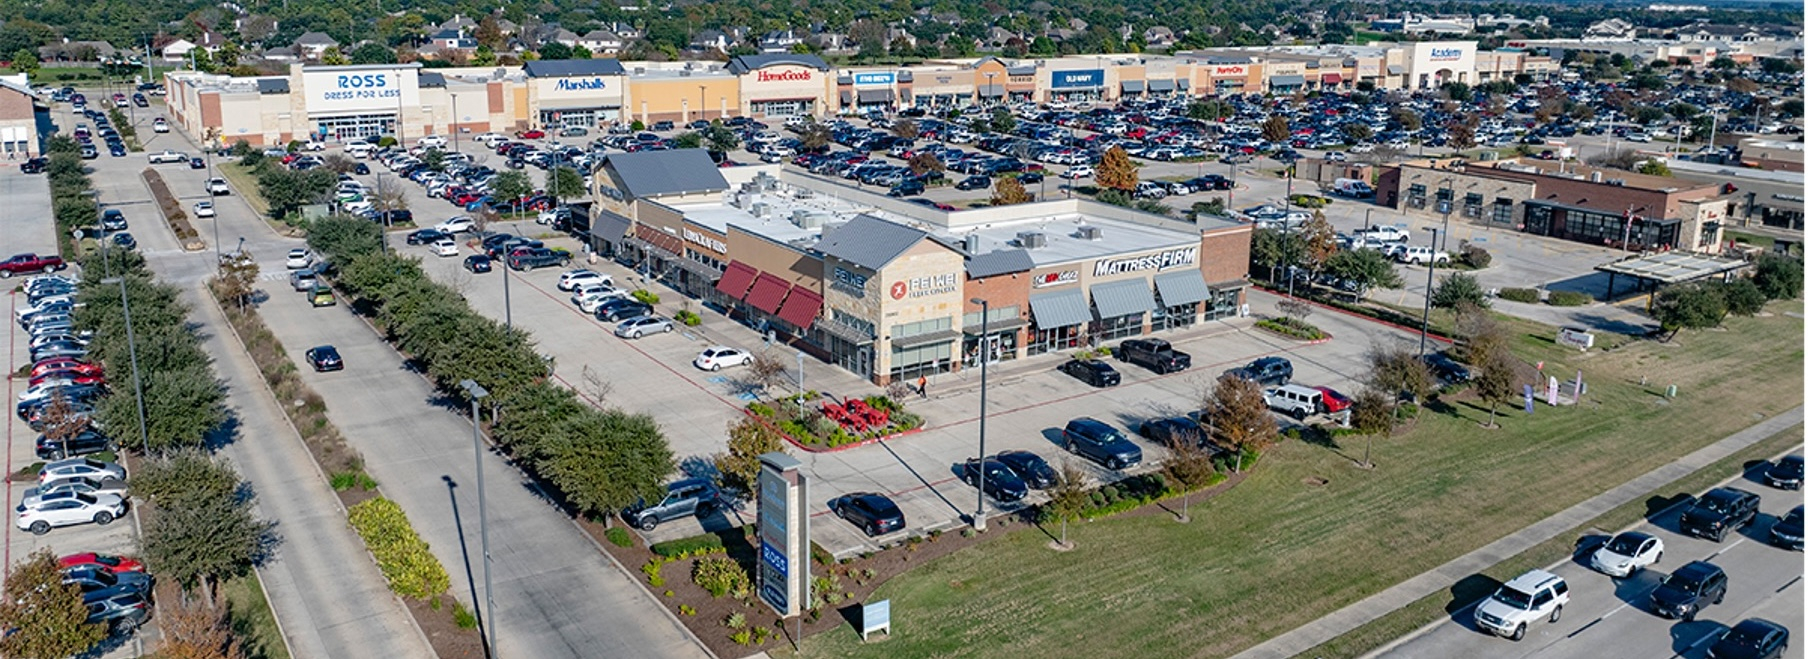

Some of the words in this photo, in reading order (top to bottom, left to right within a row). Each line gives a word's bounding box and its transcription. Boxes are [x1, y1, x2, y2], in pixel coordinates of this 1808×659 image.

[338, 74, 386, 88] ROSS
[757, 69, 811, 82] HomeGoods
[554, 78, 606, 91] Marshalls
[324, 91, 354, 100] DRESS
[356, 90, 375, 99] FOR
[378, 88, 401, 98] LESS
[909, 276, 931, 291] PEI
[764, 546, 786, 573] ROSS
